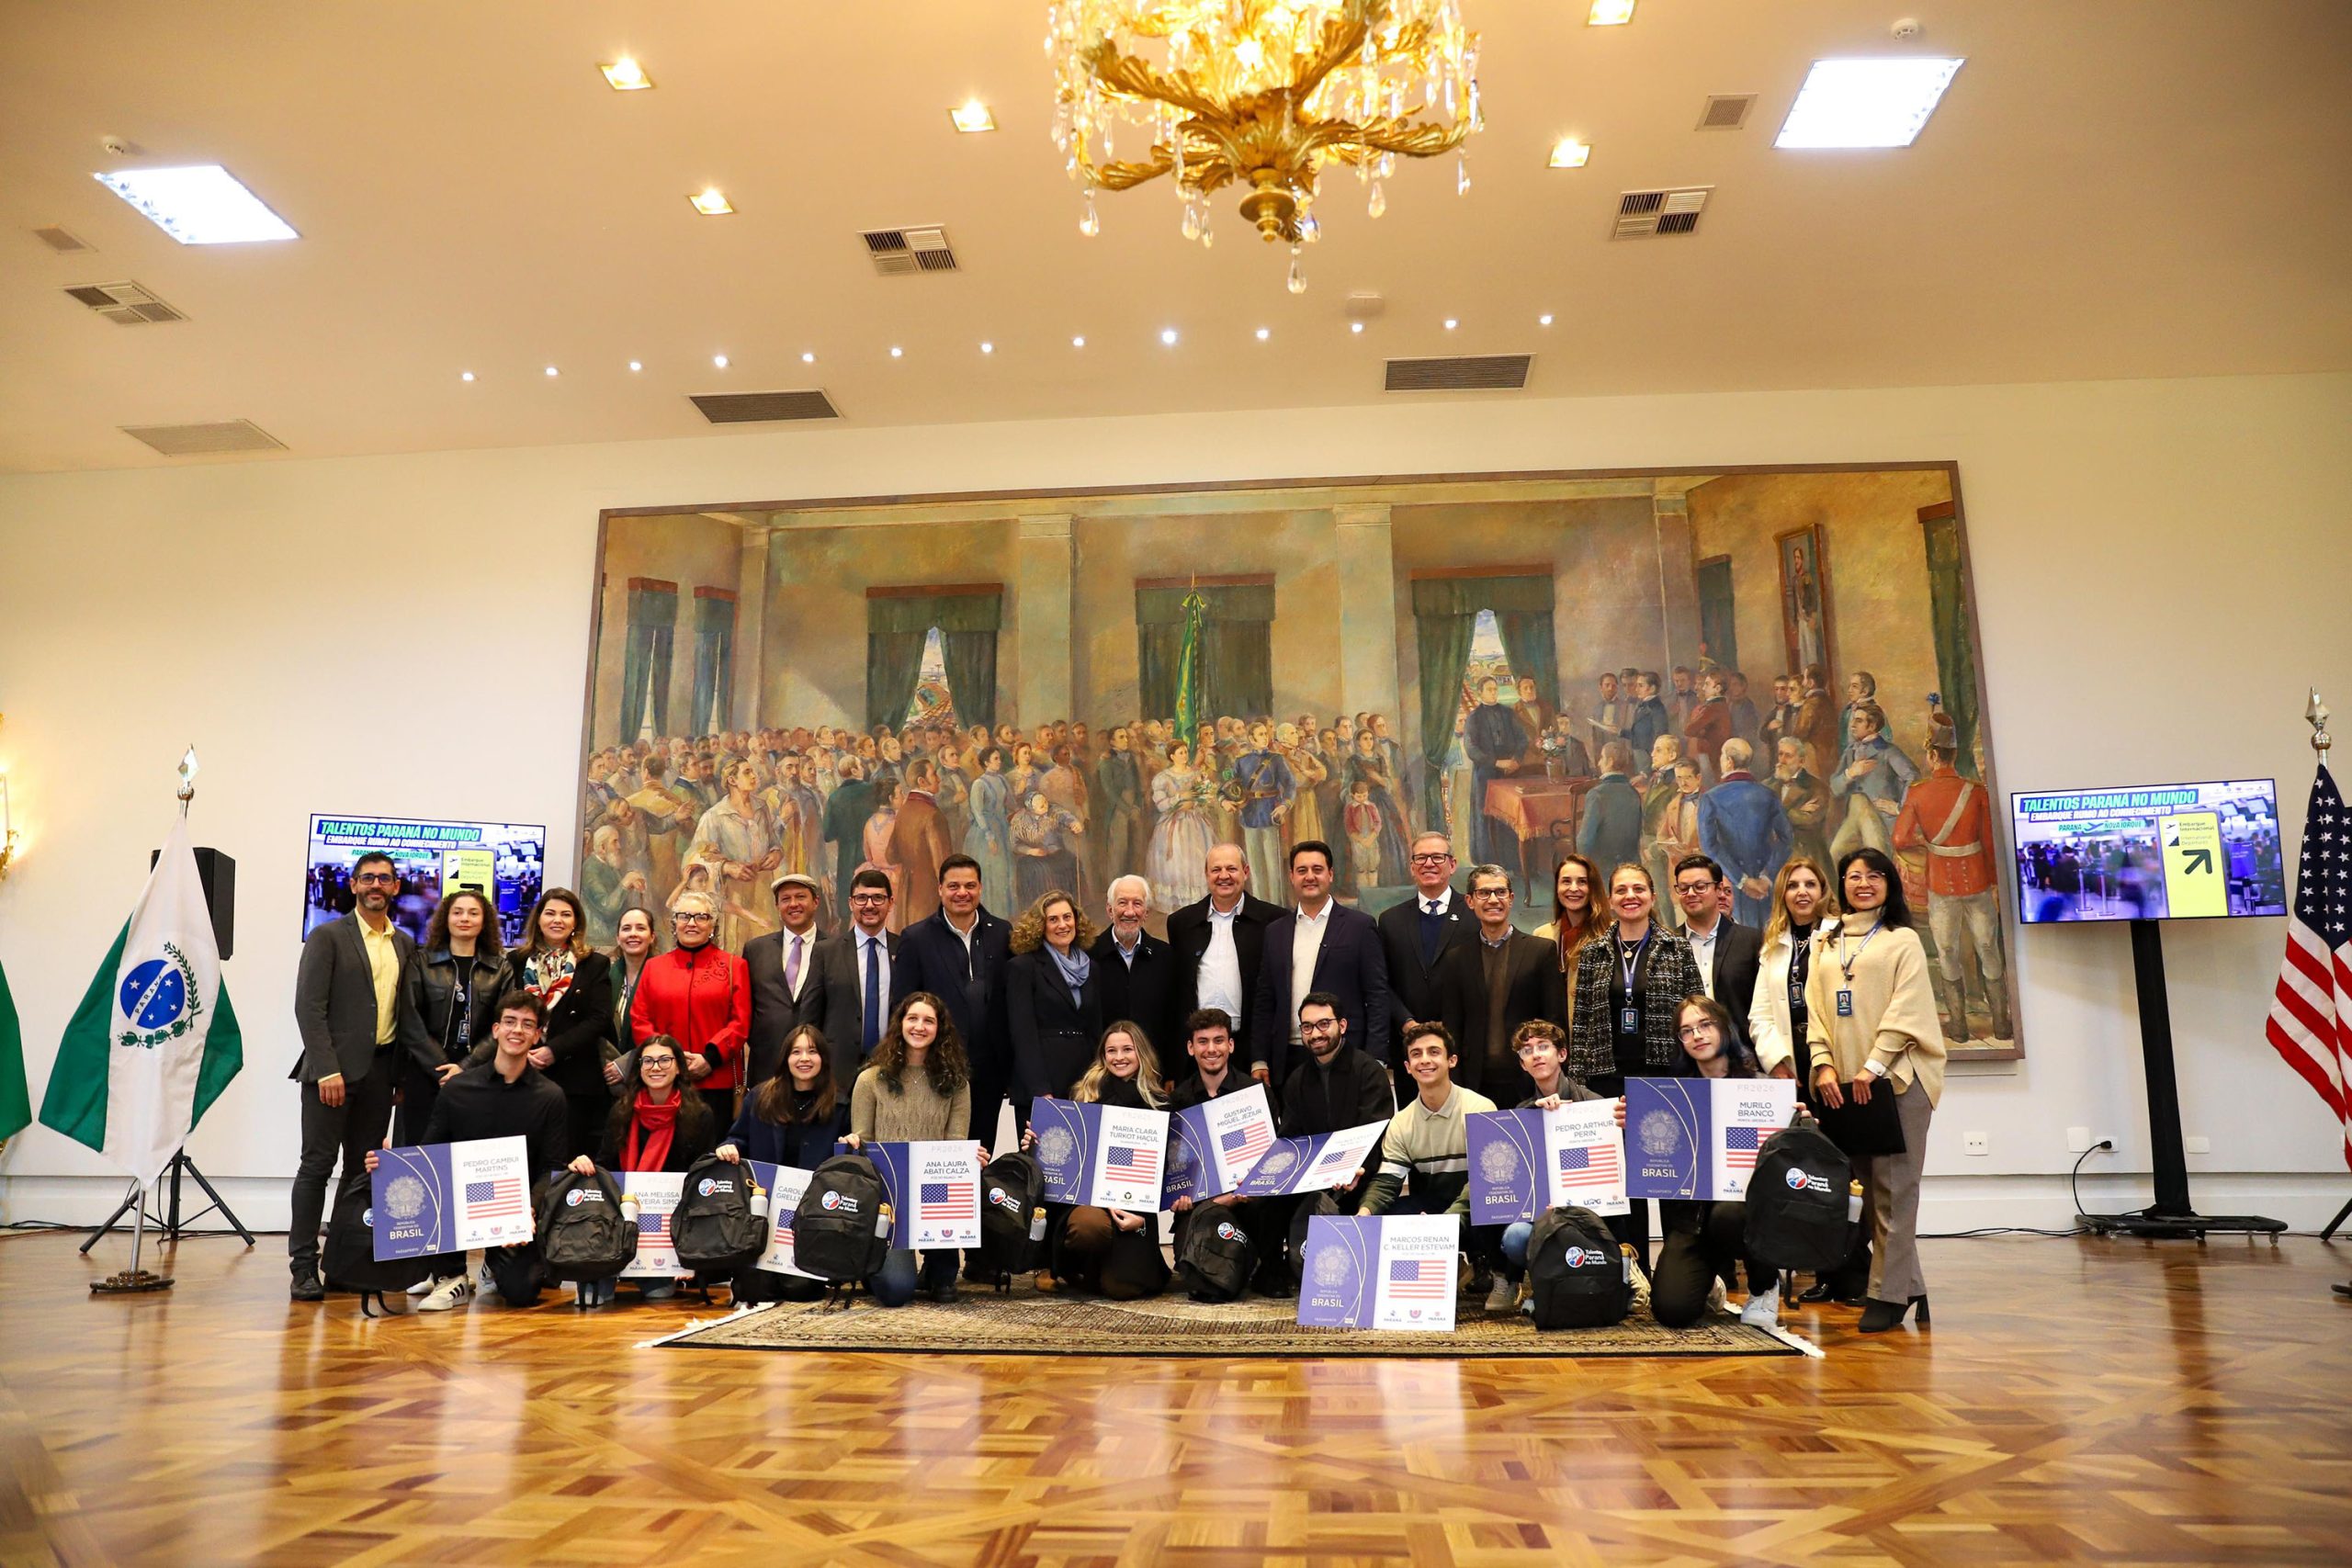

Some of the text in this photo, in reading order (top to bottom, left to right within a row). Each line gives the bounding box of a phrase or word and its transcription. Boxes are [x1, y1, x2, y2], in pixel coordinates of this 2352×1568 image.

[2023, 797, 2080, 812] TALENTOS
[2132, 793, 2148, 807] NO
[2150, 791, 2196, 805] MUNDO
[2030, 806, 2172, 821] EMBARQUE RUMO AO CONHECIMENTO
[322, 821, 376, 836] TALENTOS
[422, 826, 439, 840] NO
[439, 828, 480, 841] MUNDO
[326, 835, 368, 845] EMBARQUE
[390, 838, 401, 847] AO
[401, 839, 458, 850] CONHECIMENTO
[1224, 1105, 1252, 1119] GUSTAVO
[1217, 1117, 1240, 1128] MIGUEL
[1555, 1120, 1614, 1132] PEDRO ARTHUR
[1110, 1132, 1136, 1140] TURKOT
[1135, 1127, 1158, 1135] CLARA
[463, 1159, 489, 1168] PEDRO
[475, 1165, 508, 1173] MARTINS
[1642, 1168, 1679, 1178] BRASIL
[1043, 1176, 1066, 1185] RASIL
[1166, 1180, 1193, 1193] BRASIL
[1486, 1194, 1519, 1204] BRASIL
[390, 1228, 424, 1240] BRASIL
[1311, 1298, 1344, 1308] BRASIL
